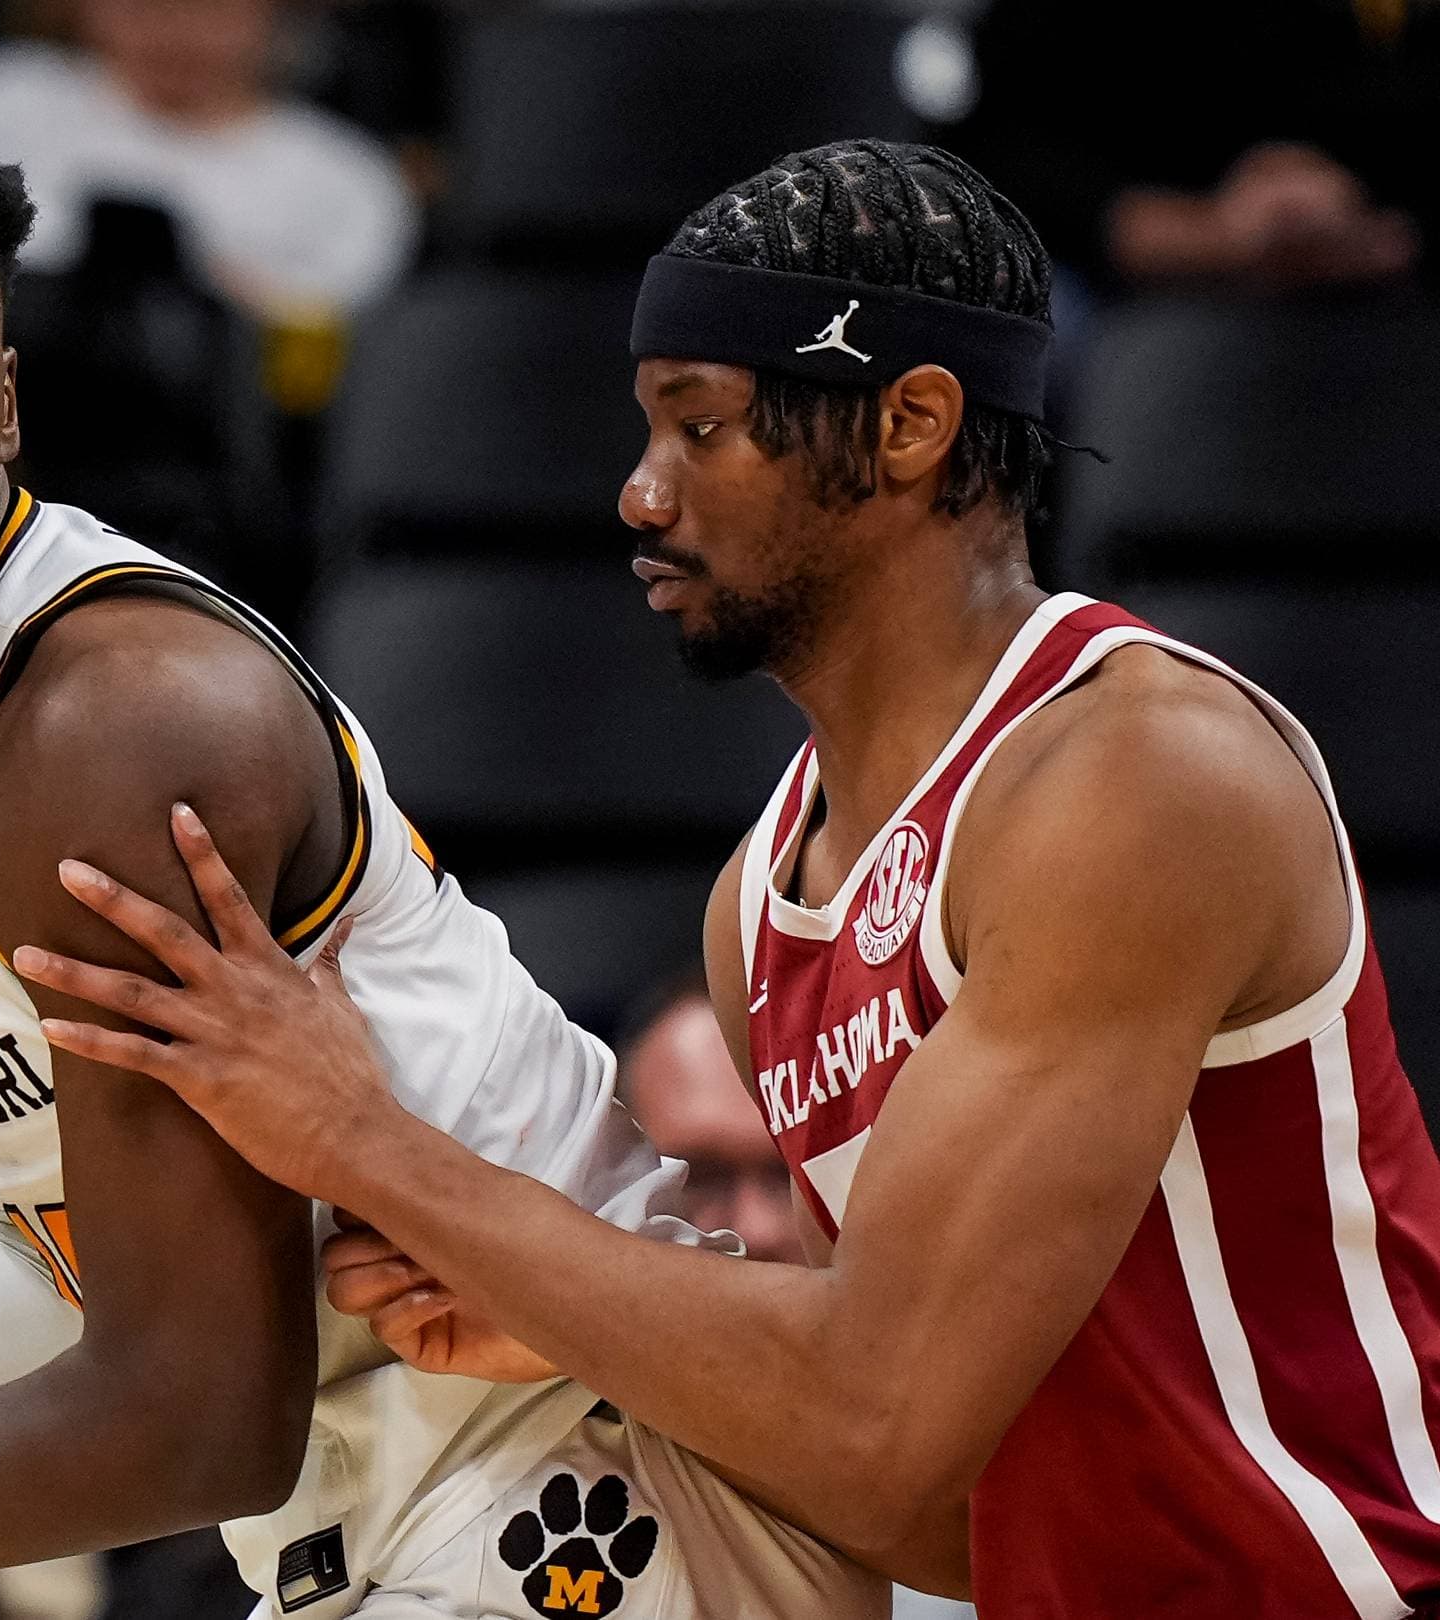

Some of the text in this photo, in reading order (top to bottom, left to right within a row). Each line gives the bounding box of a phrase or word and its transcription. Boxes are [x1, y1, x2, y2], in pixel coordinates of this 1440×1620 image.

[870, 830, 925, 927] SEC
[858, 910, 915, 962] GRADUATE
[759, 987, 922, 1135] OKLAHOMA
[322, 1551, 333, 1574] L
[543, 1565, 604, 1614] M
